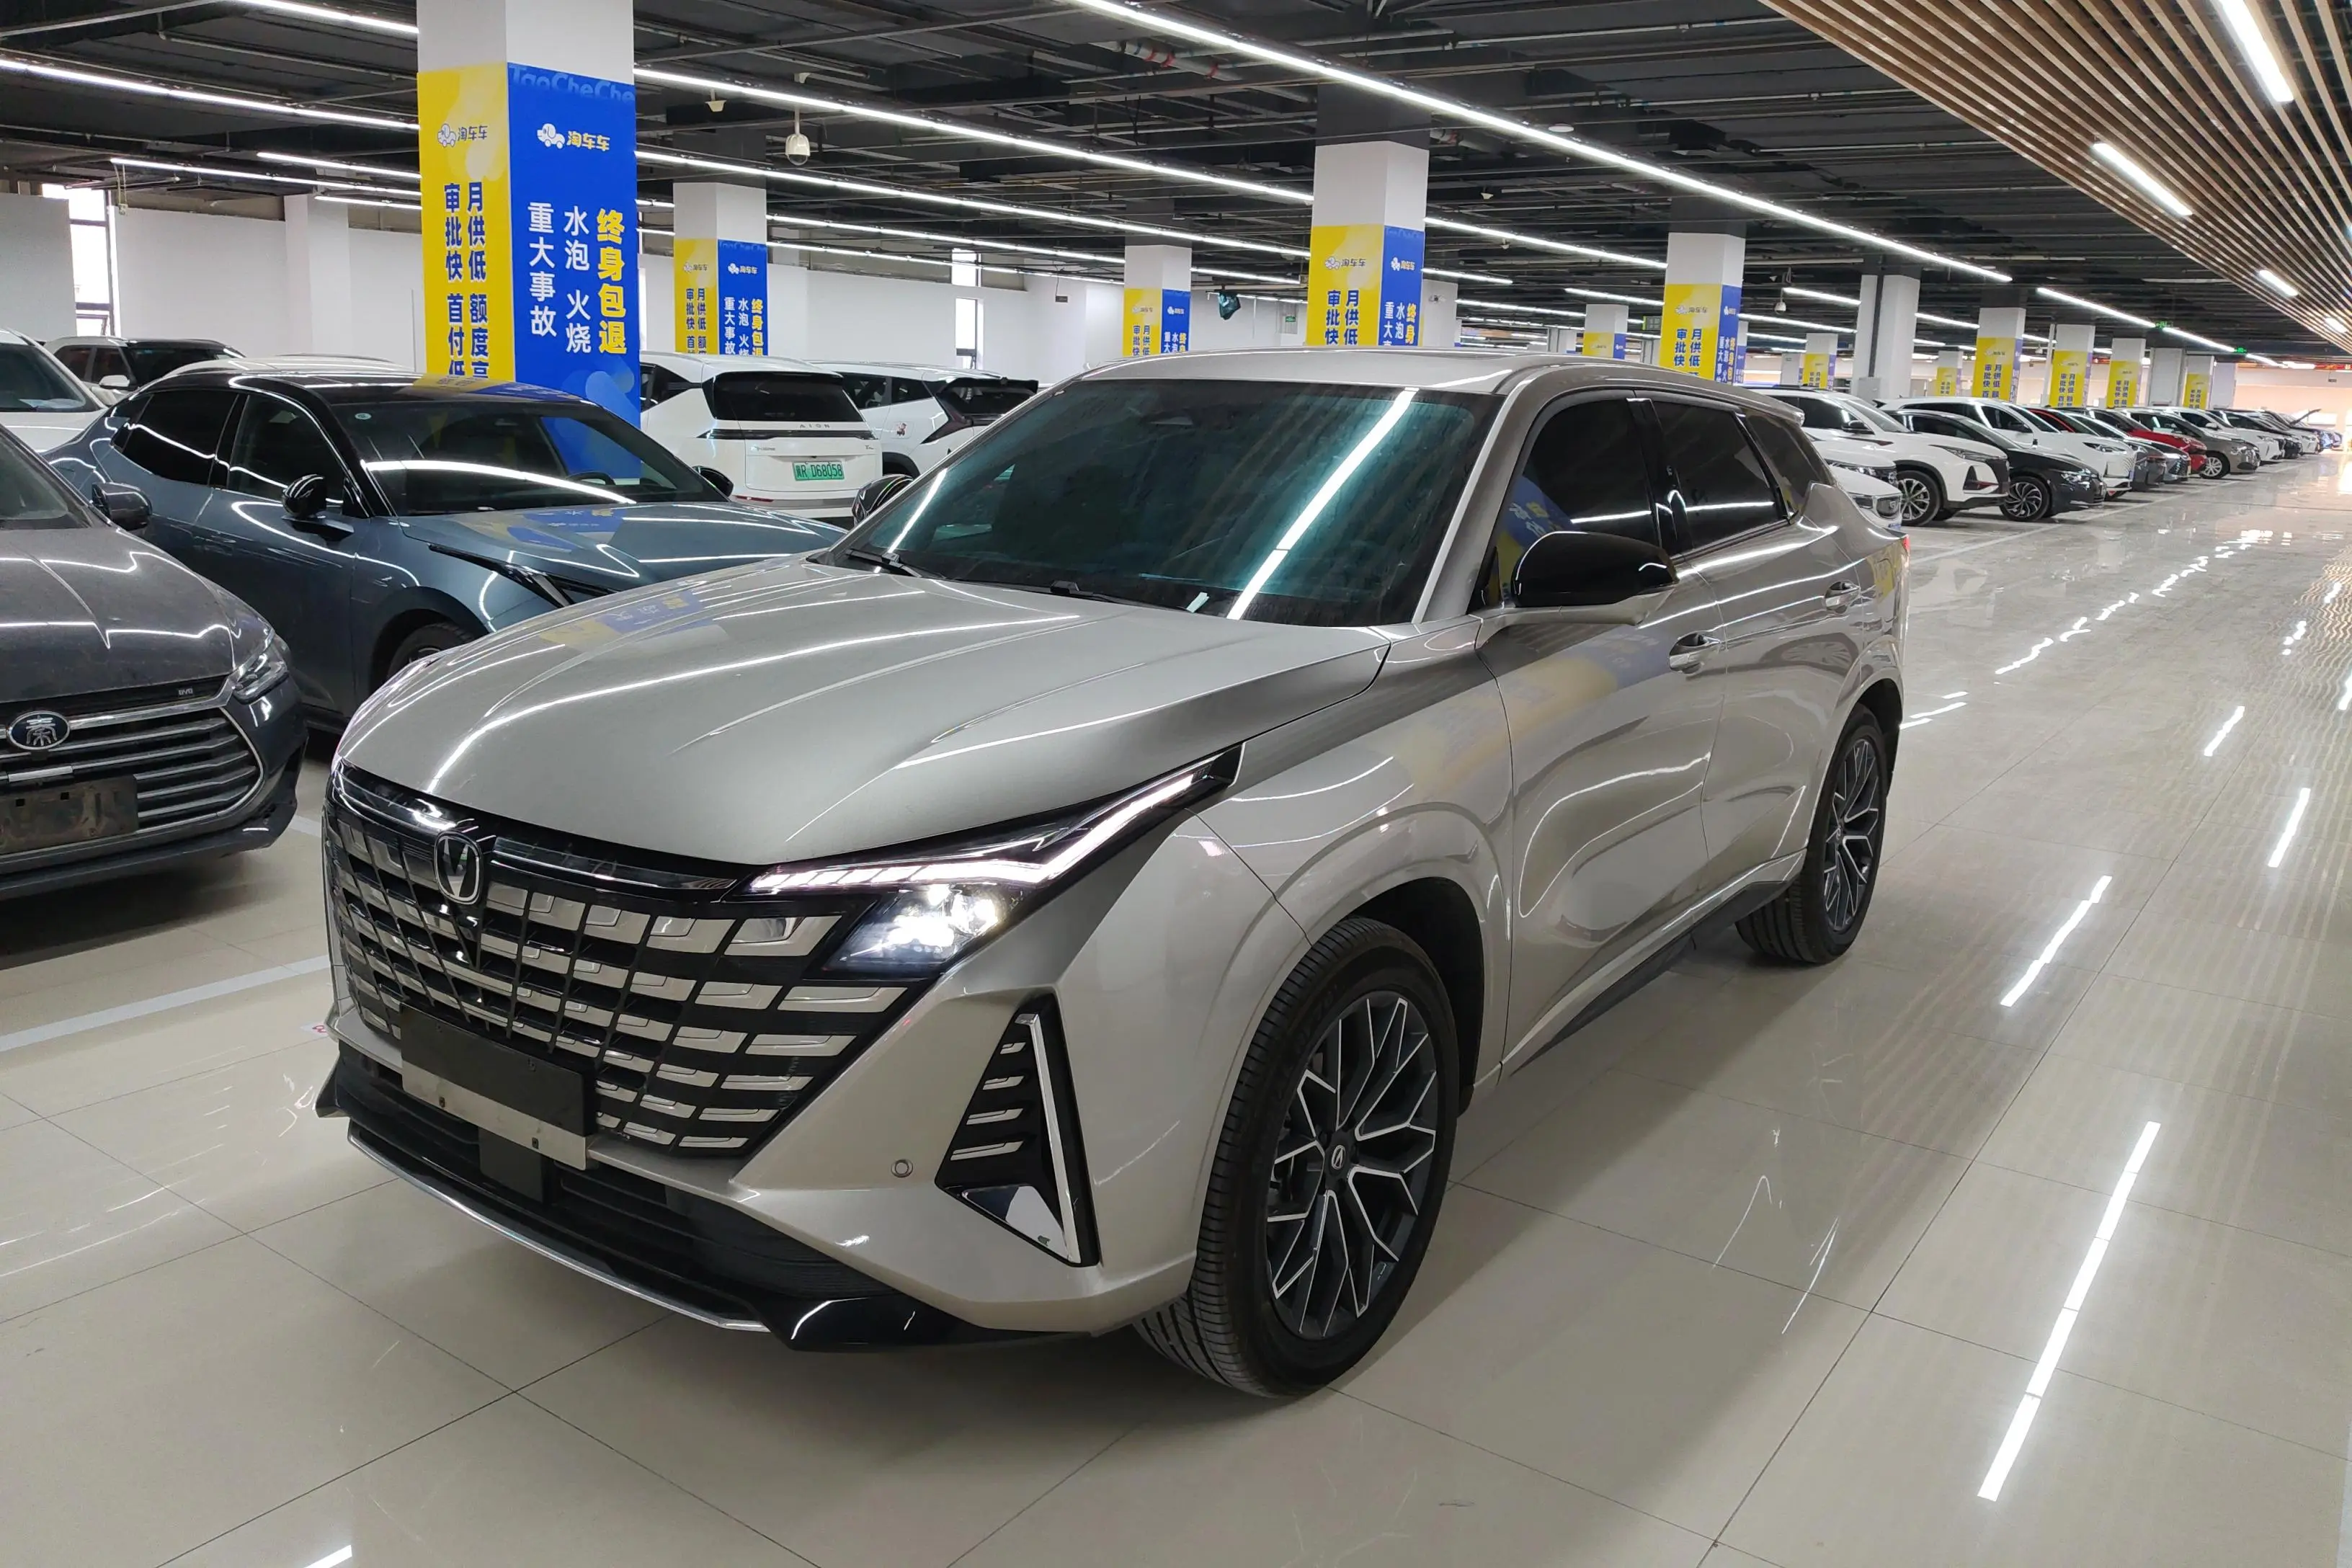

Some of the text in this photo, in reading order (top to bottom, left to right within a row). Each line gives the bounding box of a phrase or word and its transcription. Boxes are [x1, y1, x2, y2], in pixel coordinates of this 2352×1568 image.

[457, 125, 488, 141] 淘车车
[566, 130, 610, 151] 淘车车
[444, 182, 463, 282] 审批快
[467, 181, 487, 282] 月供低
[527, 202, 557, 337] 重大事故
[564, 205, 592, 353] 水泡 火烧
[597, 208, 627, 355] 终身包退
[686, 288, 695, 330] 审批快
[697, 288, 707, 331] 月供低
[738, 298, 749, 326] 水泡
[1325, 290, 1341, 345] 审批快
[1344, 290, 1360, 345] 月供低
[1383, 301, 1394, 346] 重大
[1395, 302, 1405, 339] 水泡
